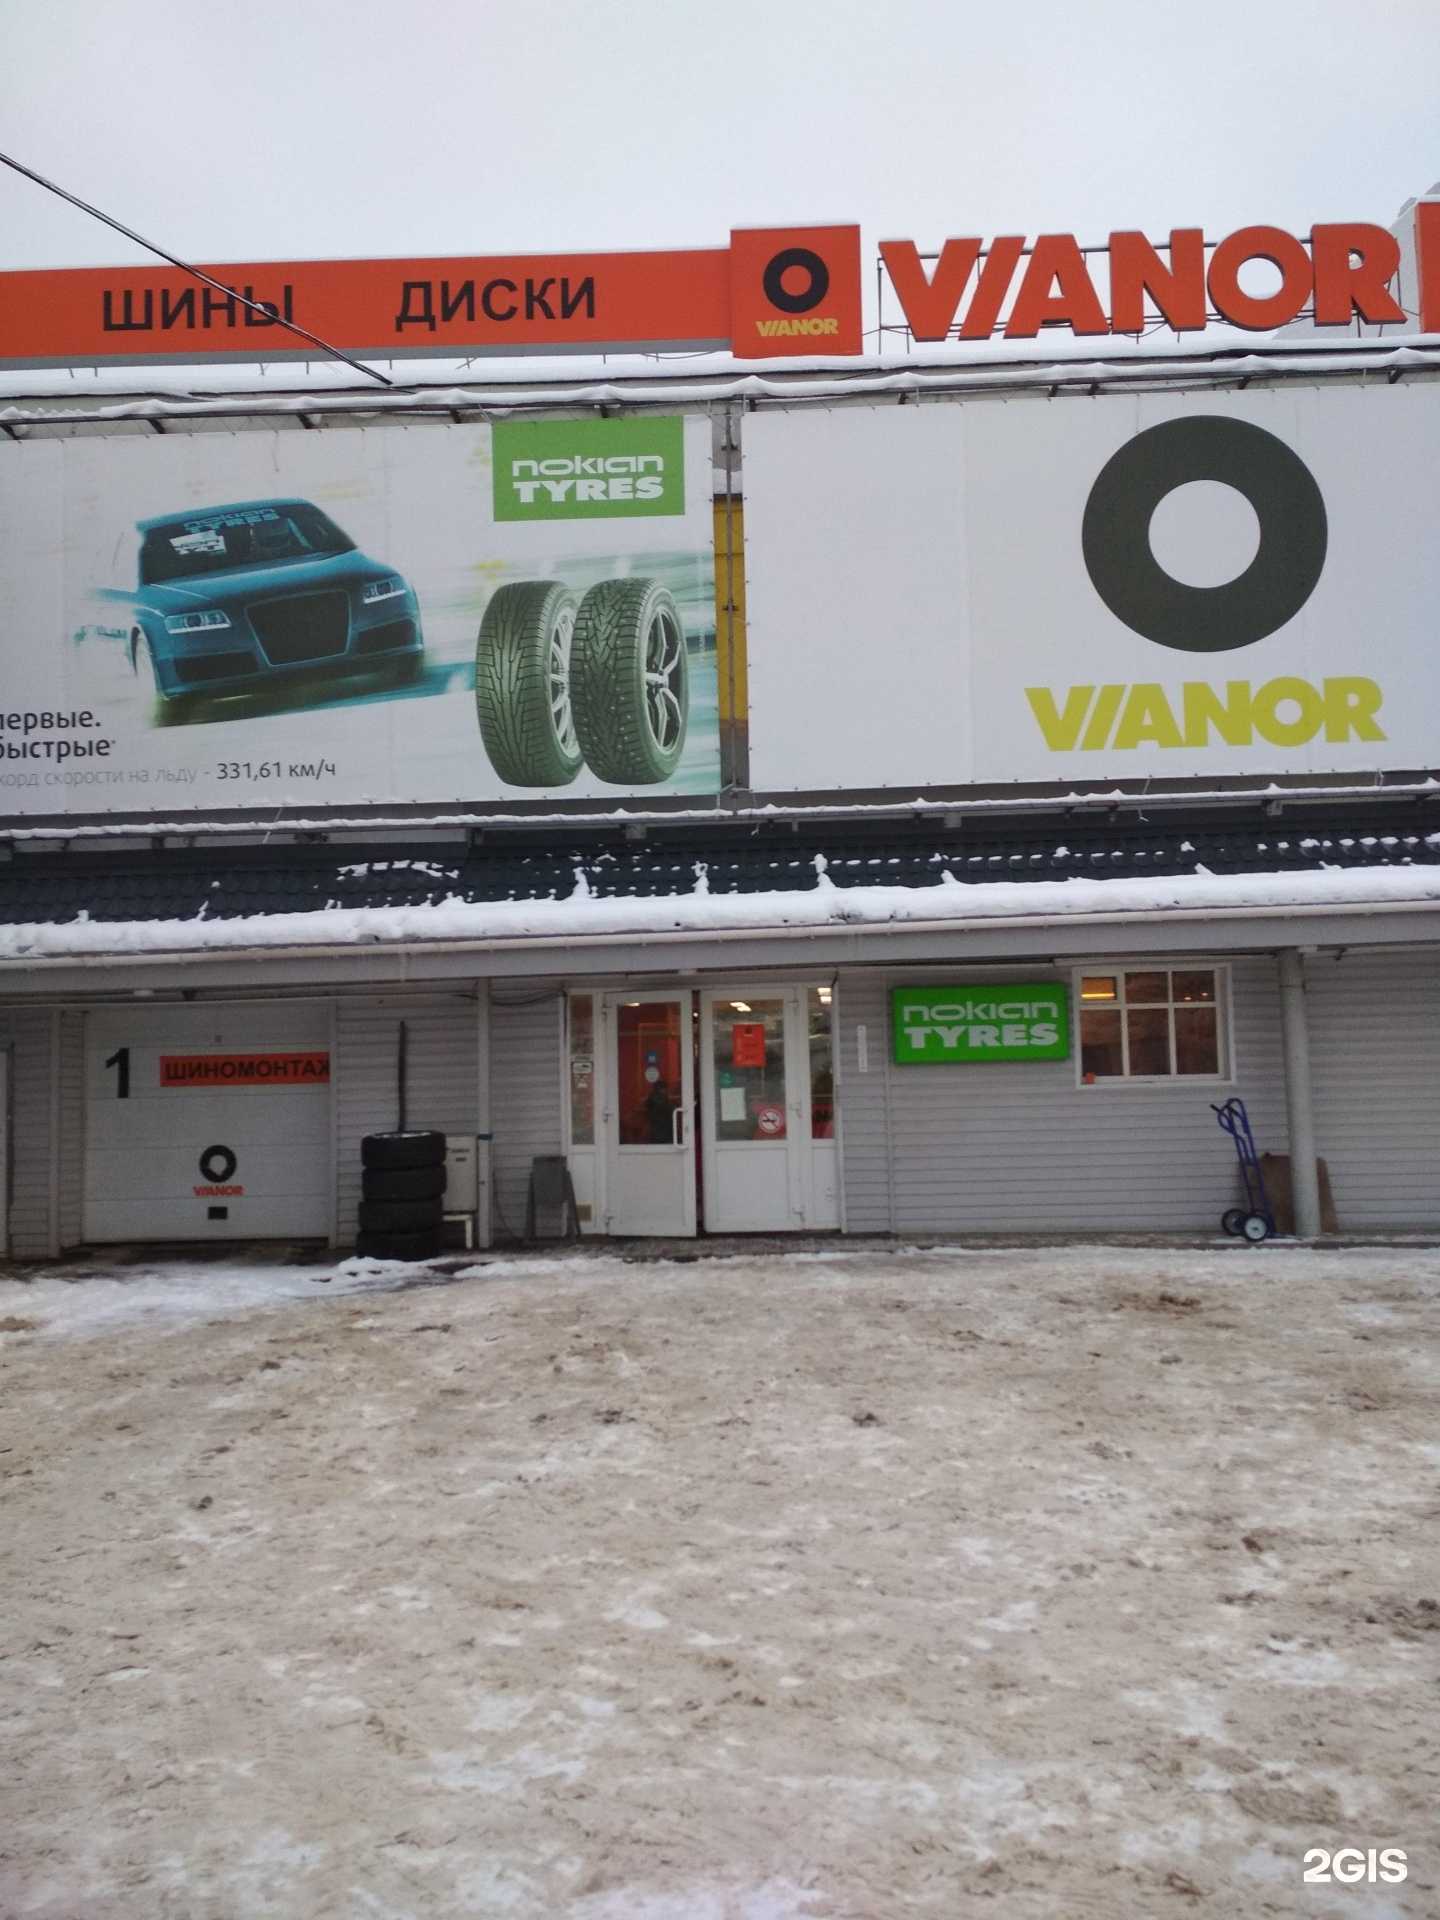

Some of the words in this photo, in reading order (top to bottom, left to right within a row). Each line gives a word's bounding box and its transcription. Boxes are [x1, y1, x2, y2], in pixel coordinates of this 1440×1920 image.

[102, 284, 295, 333] ШИНЫ
[394, 276, 596, 333] ДИСКИ
[511, 454, 665, 477] nokian
[511, 475, 665, 504] TYRES
[129, 770, 151, 783] на
[216, 762, 283, 782] 331,61
[288, 758, 337, 782] км/ч
[904, 1022, 1060, 1050] TYRES
[105, 1047, 131, 1099] 1
